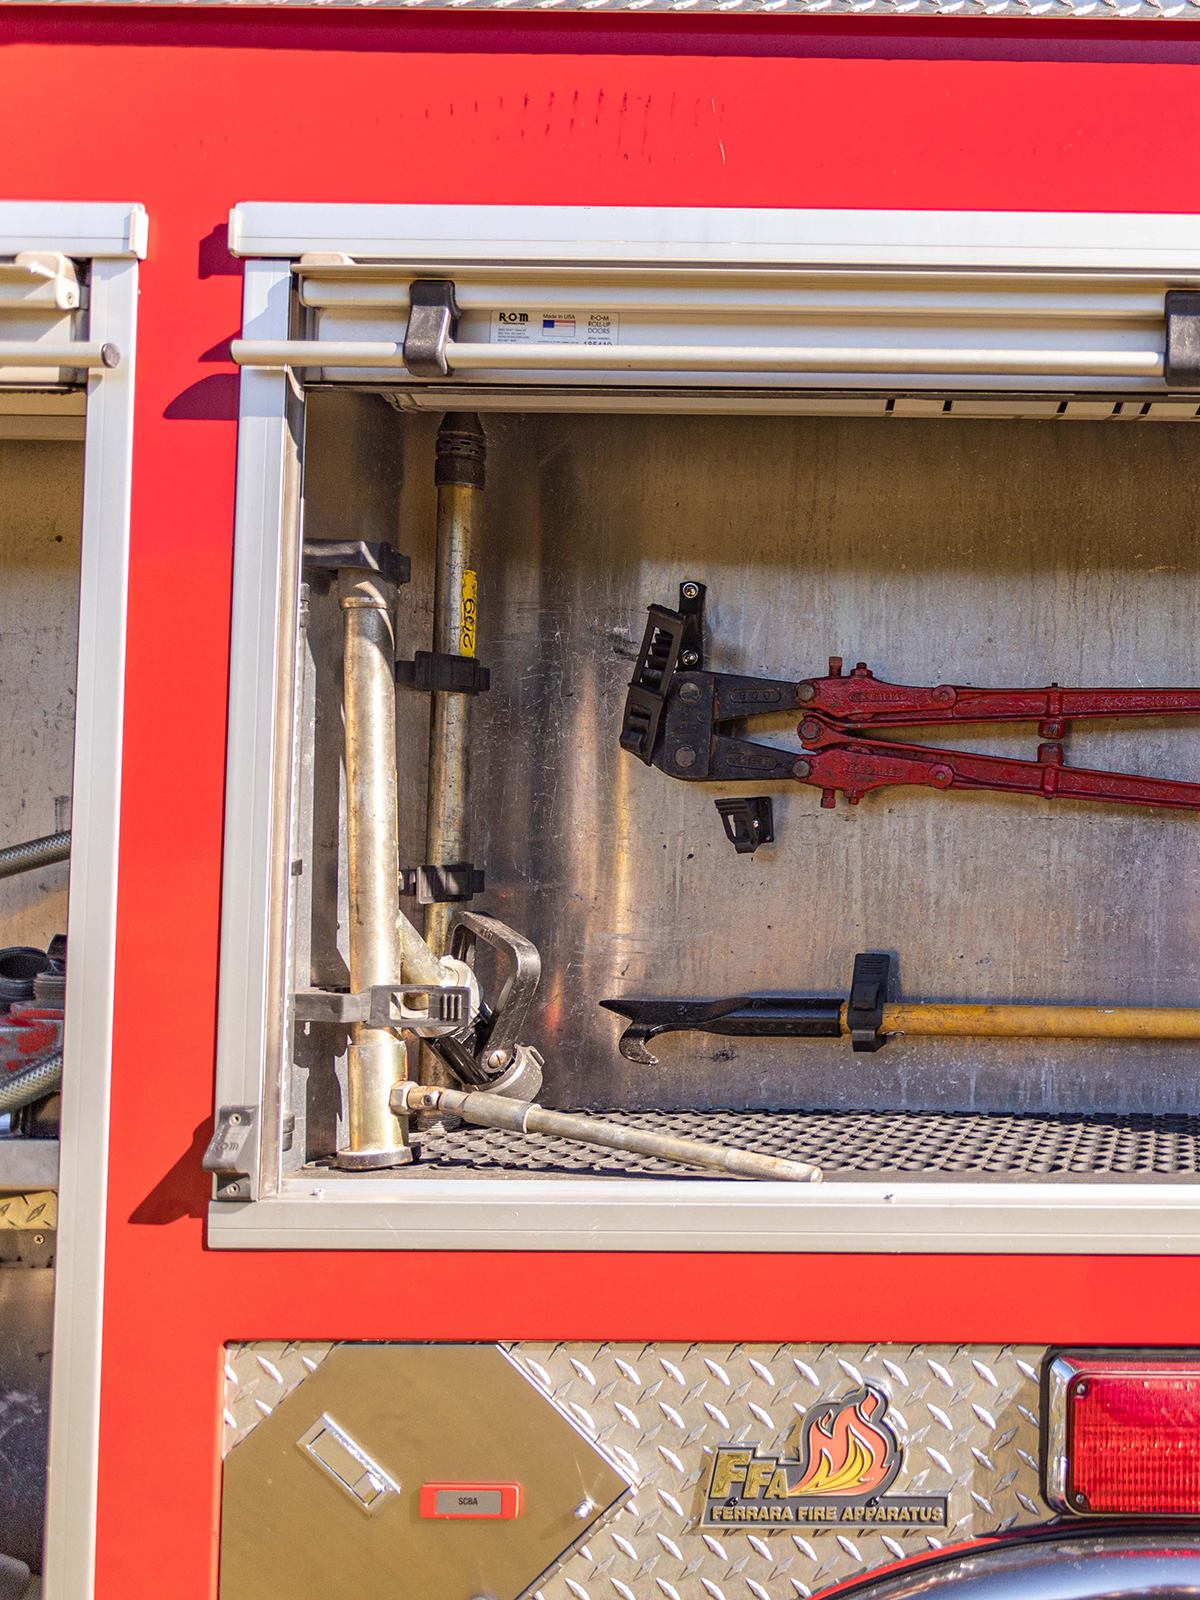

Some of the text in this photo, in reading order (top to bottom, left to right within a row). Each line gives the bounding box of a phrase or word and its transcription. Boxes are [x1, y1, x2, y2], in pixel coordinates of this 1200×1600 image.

[709, 1450, 789, 1499] FFA
[457, 1496, 479, 1506] SCBA
[711, 1505, 943, 1522] FERRARA FIRE APPARATUS
